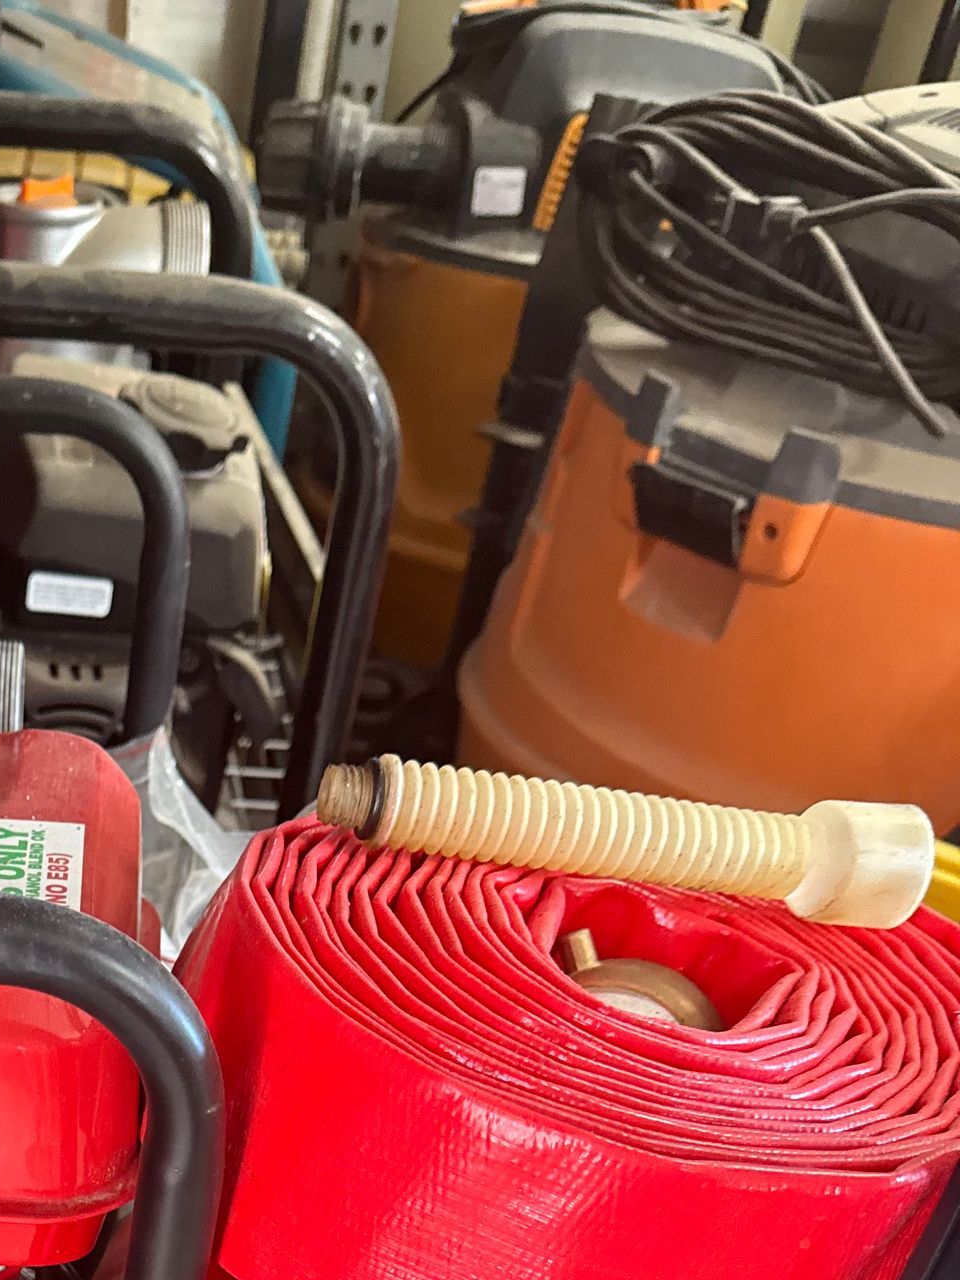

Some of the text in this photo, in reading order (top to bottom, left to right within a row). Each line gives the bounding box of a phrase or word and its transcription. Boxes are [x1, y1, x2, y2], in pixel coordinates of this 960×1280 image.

[30, 829, 46, 841] OK
[28, 843, 44, 869] BLEND
[46, 853, 73, 881] E85)
